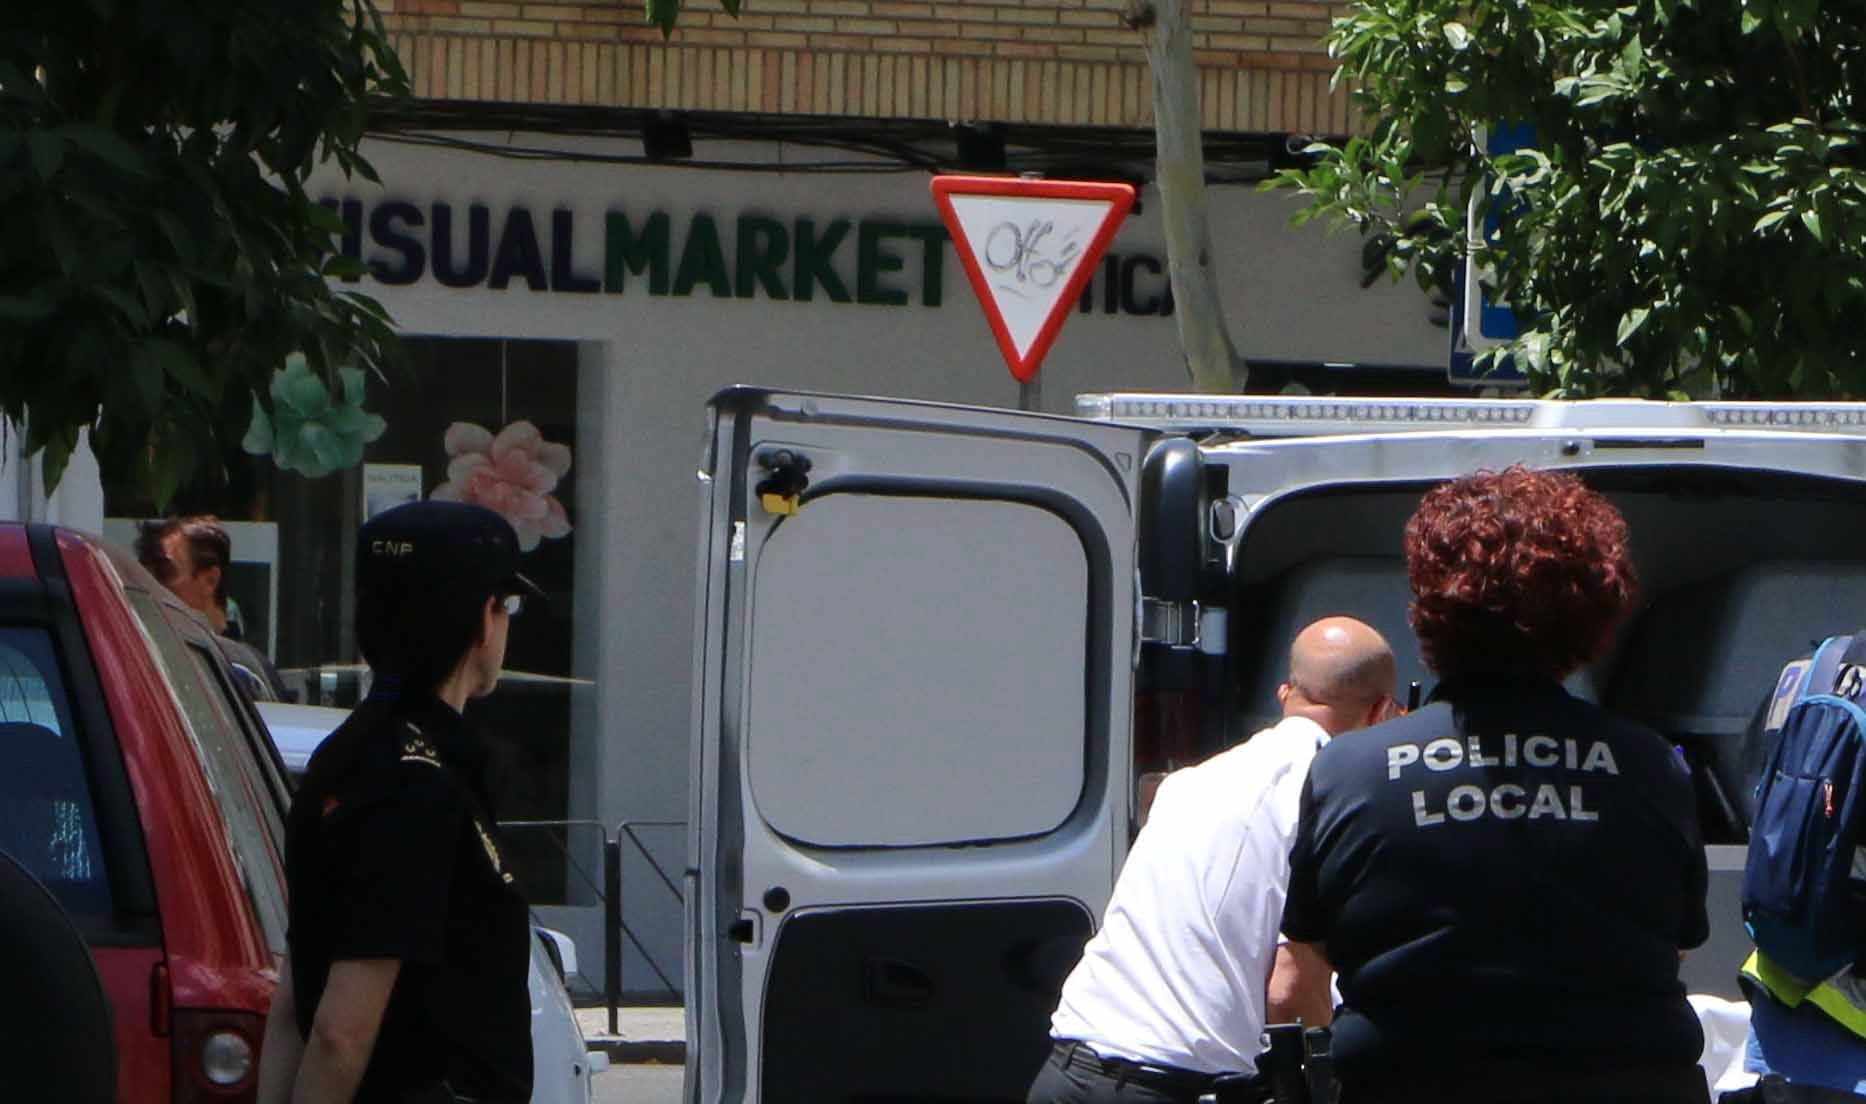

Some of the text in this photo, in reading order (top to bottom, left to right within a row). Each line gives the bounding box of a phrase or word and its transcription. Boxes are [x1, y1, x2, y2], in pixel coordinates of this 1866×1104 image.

[318, 196, 953, 308] ISUALMARKET
[371, 540, 414, 556] CNP
[1387, 734, 1619, 781] POLICIA
[1412, 783, 1599, 827] LOCAL
